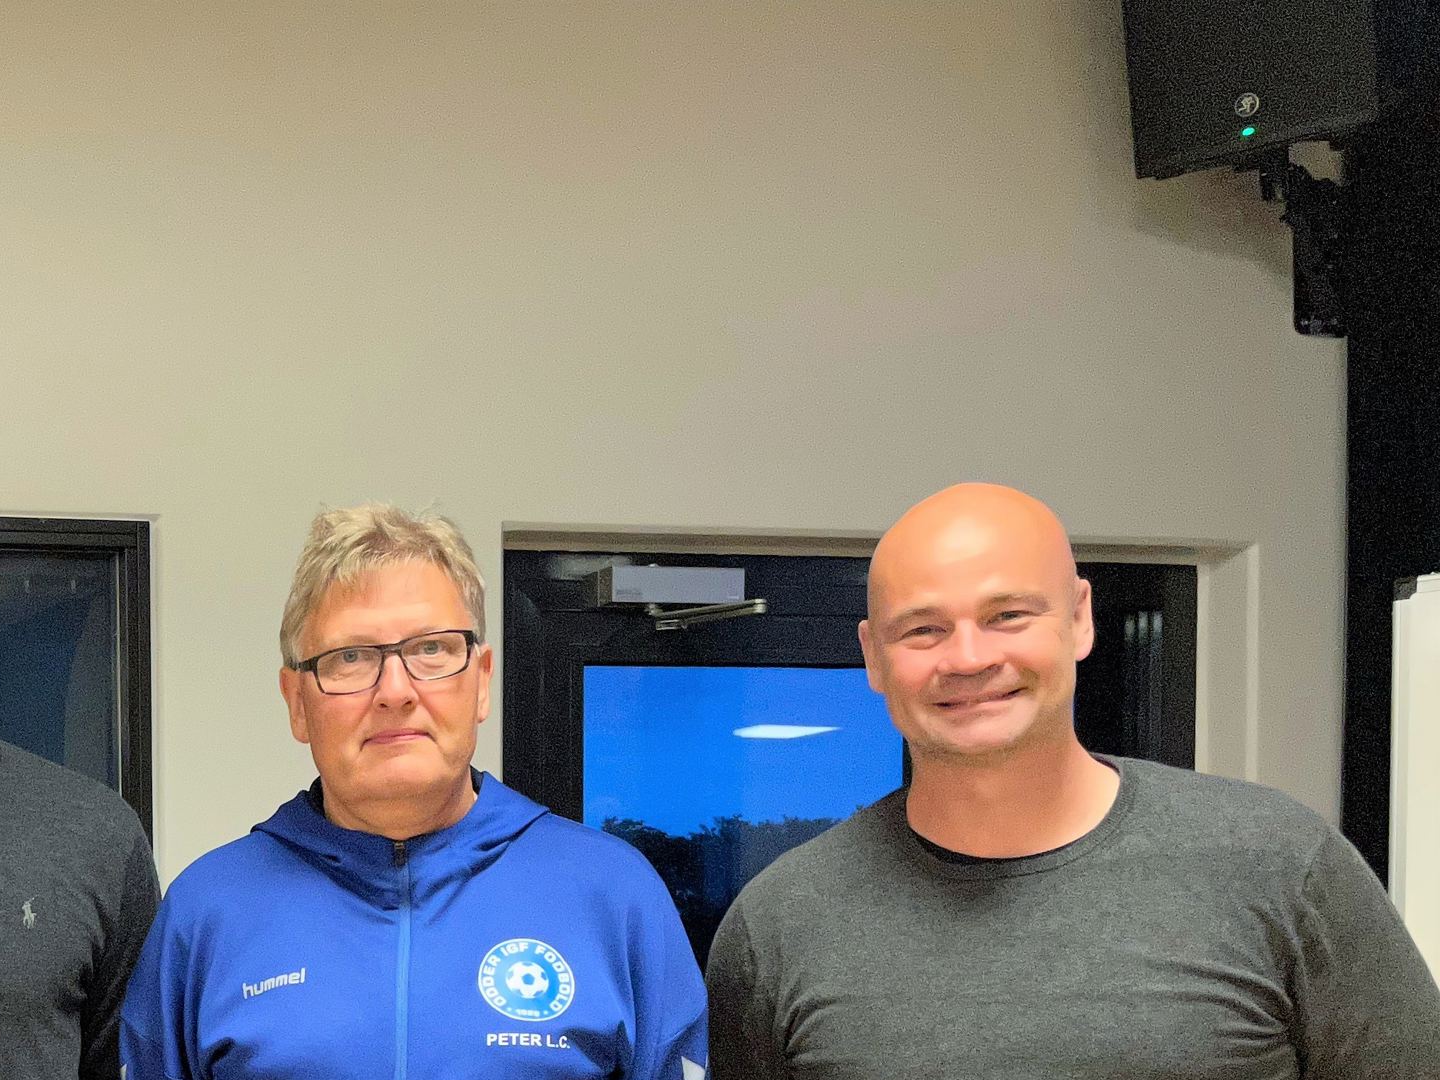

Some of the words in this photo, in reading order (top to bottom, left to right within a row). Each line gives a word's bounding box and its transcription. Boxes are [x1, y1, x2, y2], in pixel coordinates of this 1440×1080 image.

[242, 967, 306, 1000] hummel
[482, 954, 507, 1007] ODDER
[500, 942, 529, 956] IGF
[534, 945, 571, 1011] FODBOLD
[486, 1032, 542, 1047] PETER
[546, 1034, 571, 1049] L.C.
